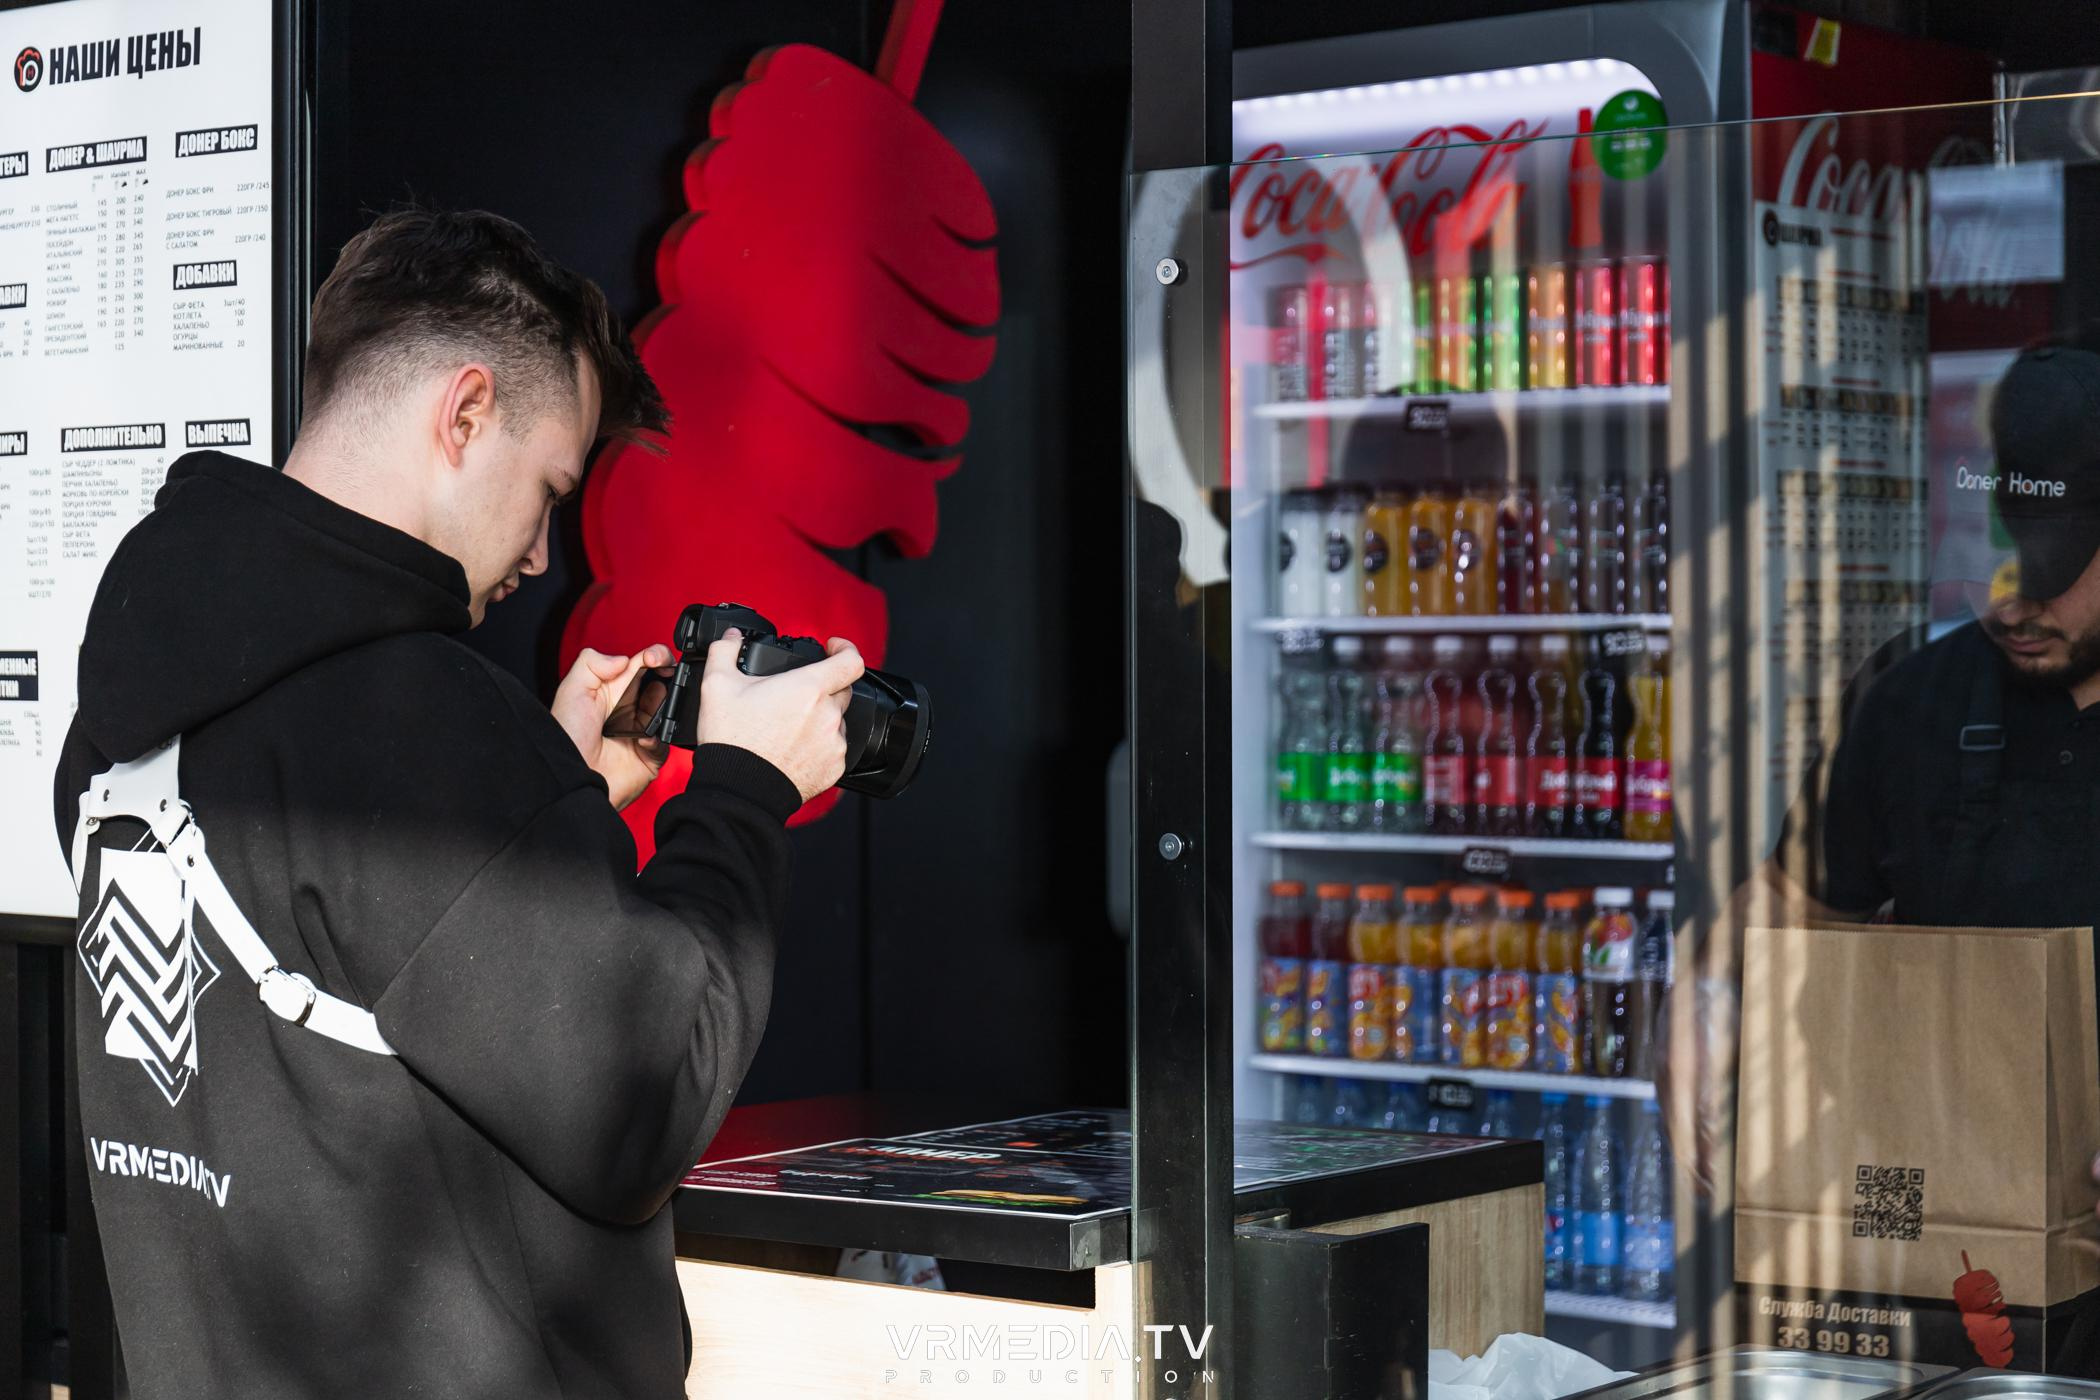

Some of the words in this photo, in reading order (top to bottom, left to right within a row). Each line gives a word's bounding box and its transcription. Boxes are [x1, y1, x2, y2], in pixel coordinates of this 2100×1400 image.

[50, 38, 120, 85] НАШИ
[127, 27, 200, 79] ЦЕНЫ
[49, 146, 85, 171] ДОНЕР
[86, 147, 94, 164] &
[96, 138, 144, 163] ШАУРМА
[179, 132, 219, 156] ДОНЕР
[221, 128, 254, 150] БОКС
[176, 262, 234, 288] ДОБАВКИ
[188, 301, 204, 309] ФЕТА
[64, 425, 162, 451] ДОПОЛНИТЕЛЬНО
[187, 422, 248, 444] ВЫПЕЧКА
[2009, 472, 2066, 497] Home
[1759, 1295, 1824, 1319] Служба
[1827, 1303, 1911, 1327] Доставки
[1778, 1327, 1810, 1349] 33
[1817, 1330, 1849, 1353] 99
[1856, 1333, 1889, 1357] 33
